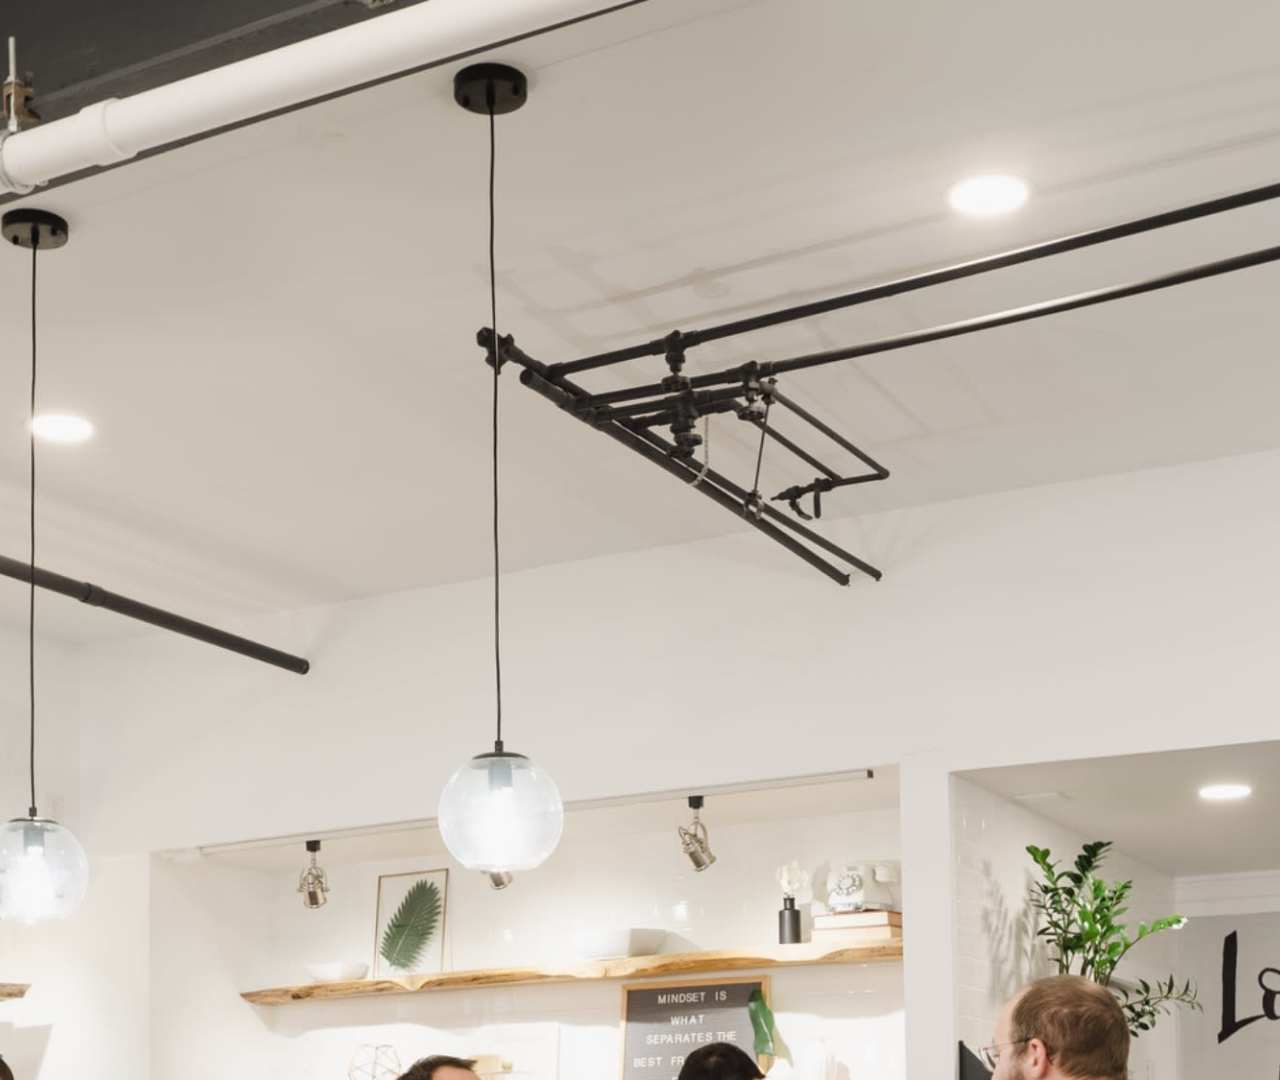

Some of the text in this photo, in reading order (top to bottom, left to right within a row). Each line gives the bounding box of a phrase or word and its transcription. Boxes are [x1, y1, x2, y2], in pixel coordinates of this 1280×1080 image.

[657, 990, 728, 1005] MINDSET IS
[670, 1014, 705, 1025] WHAT
[645, 1030, 737, 1045] SEPARATES THE
[632, 1055, 685, 1068] BEST FR
